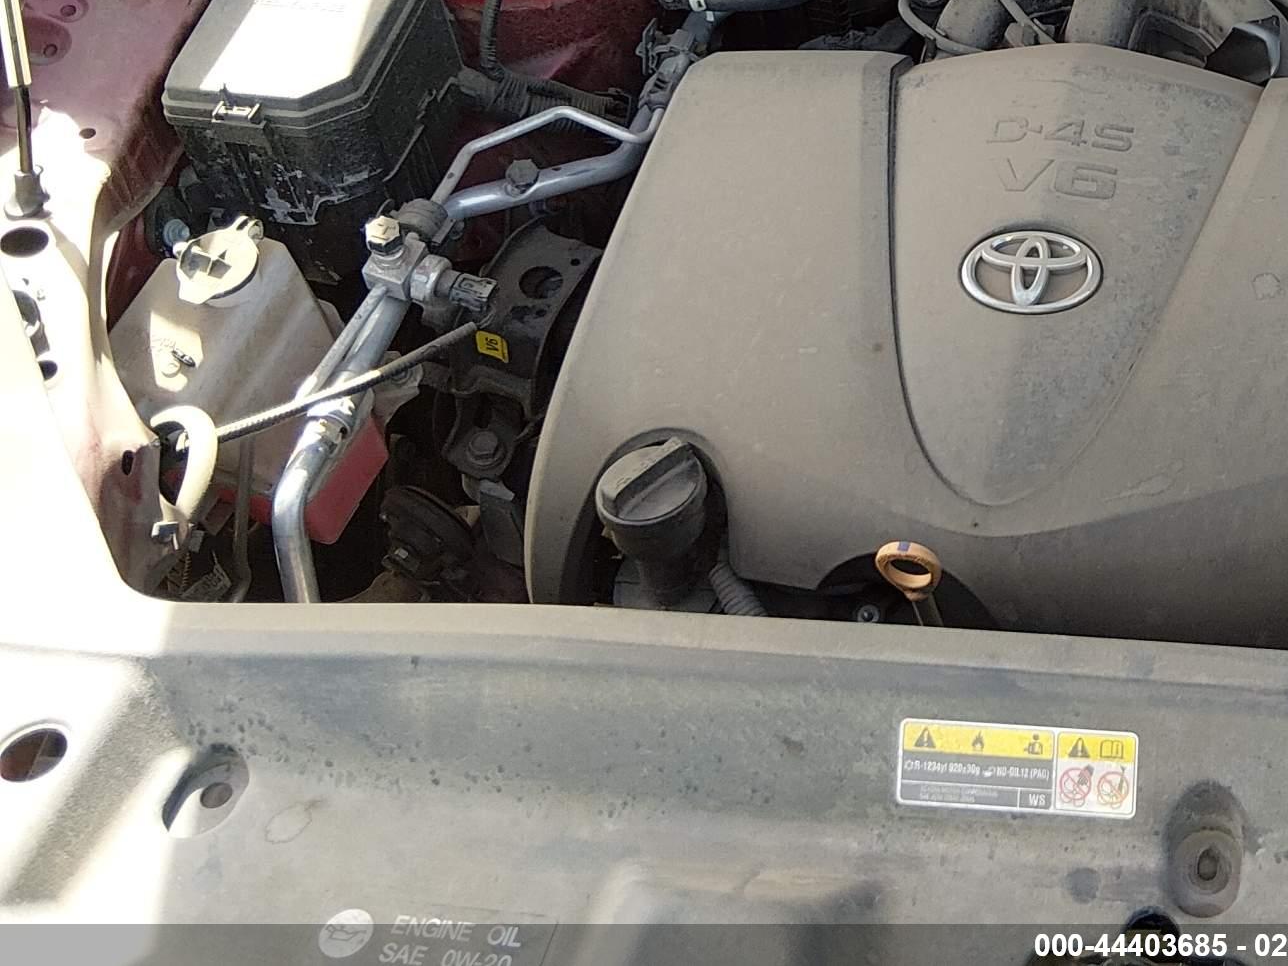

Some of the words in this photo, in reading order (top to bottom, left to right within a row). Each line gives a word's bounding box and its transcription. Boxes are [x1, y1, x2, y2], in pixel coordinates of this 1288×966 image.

[992, 158, 1118, 200] V6
[485, 337, 499, 352] V6
[1029, 793, 1046, 807] WS
[389, 915, 475, 943] ENGINE
[486, 925, 521, 948] OIL
[378, 942, 430, 966] SAE
